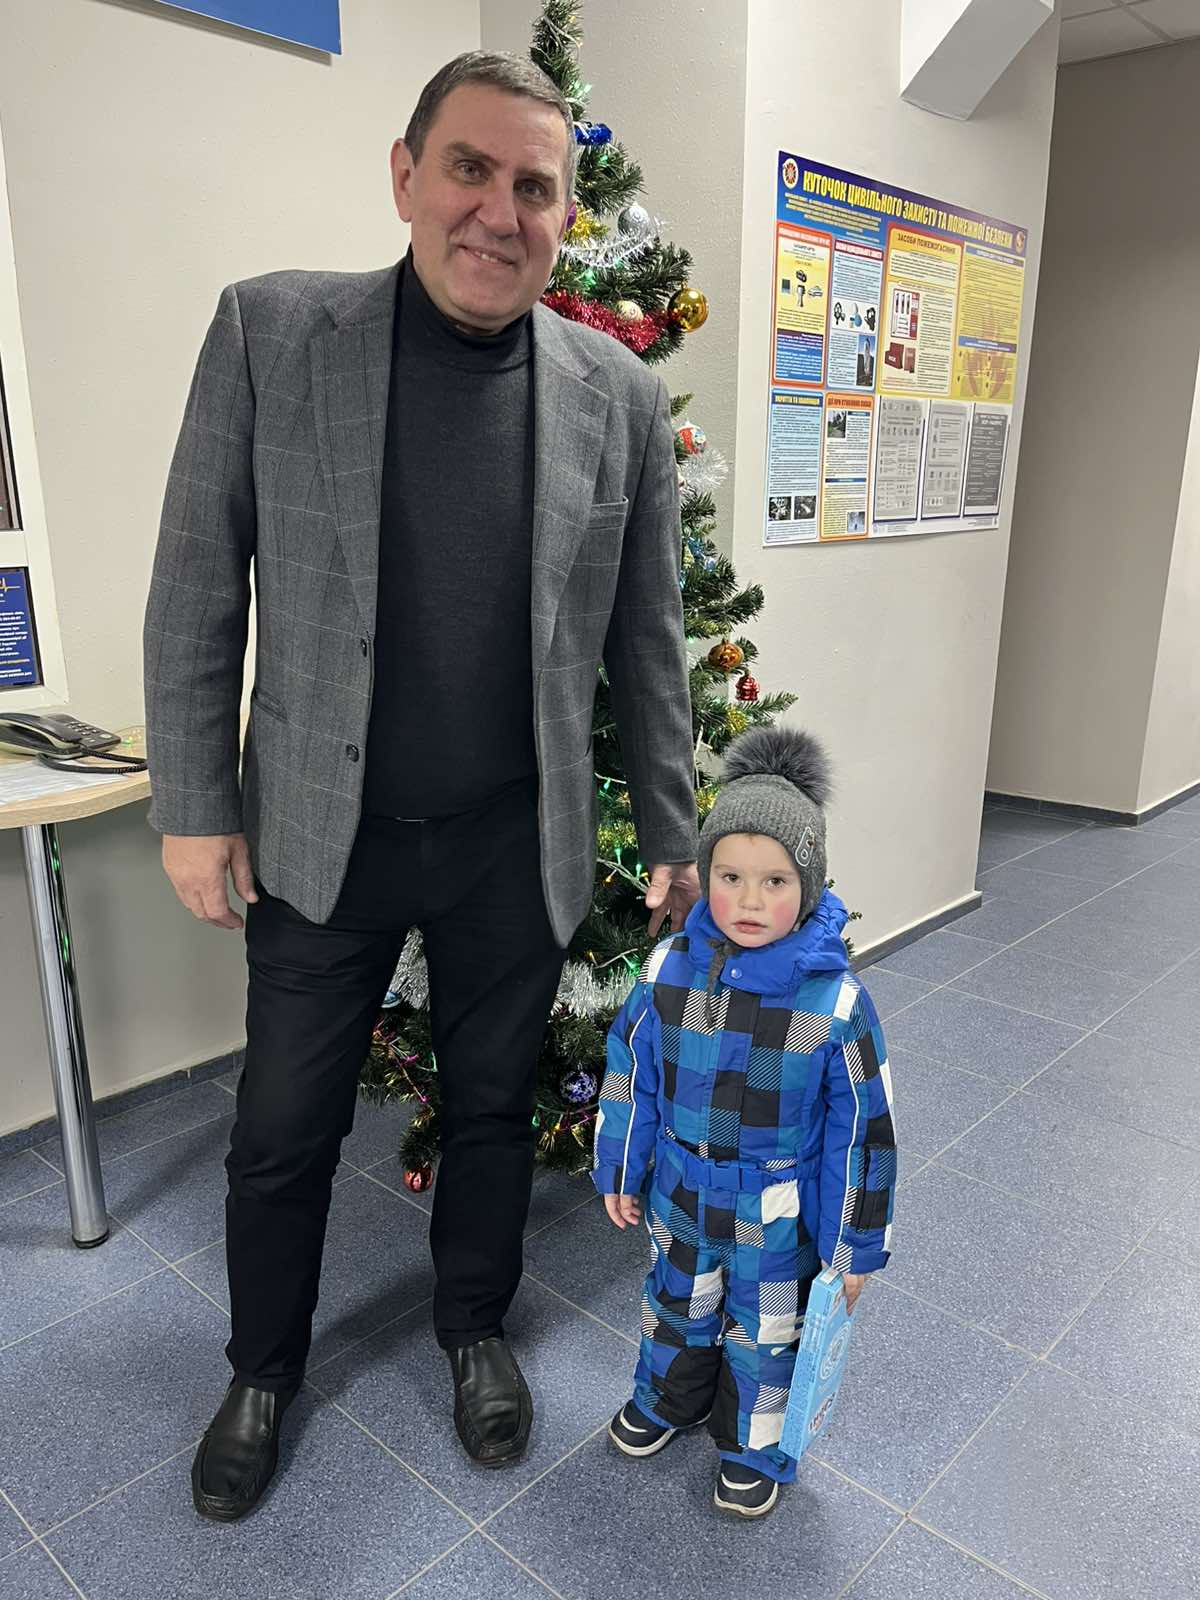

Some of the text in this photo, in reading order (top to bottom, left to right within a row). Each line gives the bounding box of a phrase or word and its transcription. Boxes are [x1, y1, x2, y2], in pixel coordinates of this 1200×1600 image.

[803, 170, 847, 201] КУТОЧОК
[847, 184, 903, 216] ЦИВІЛЬНОГО
[903, 200, 938, 226] ЗАХИСТУ
[938, 211, 947, 230] ТА
